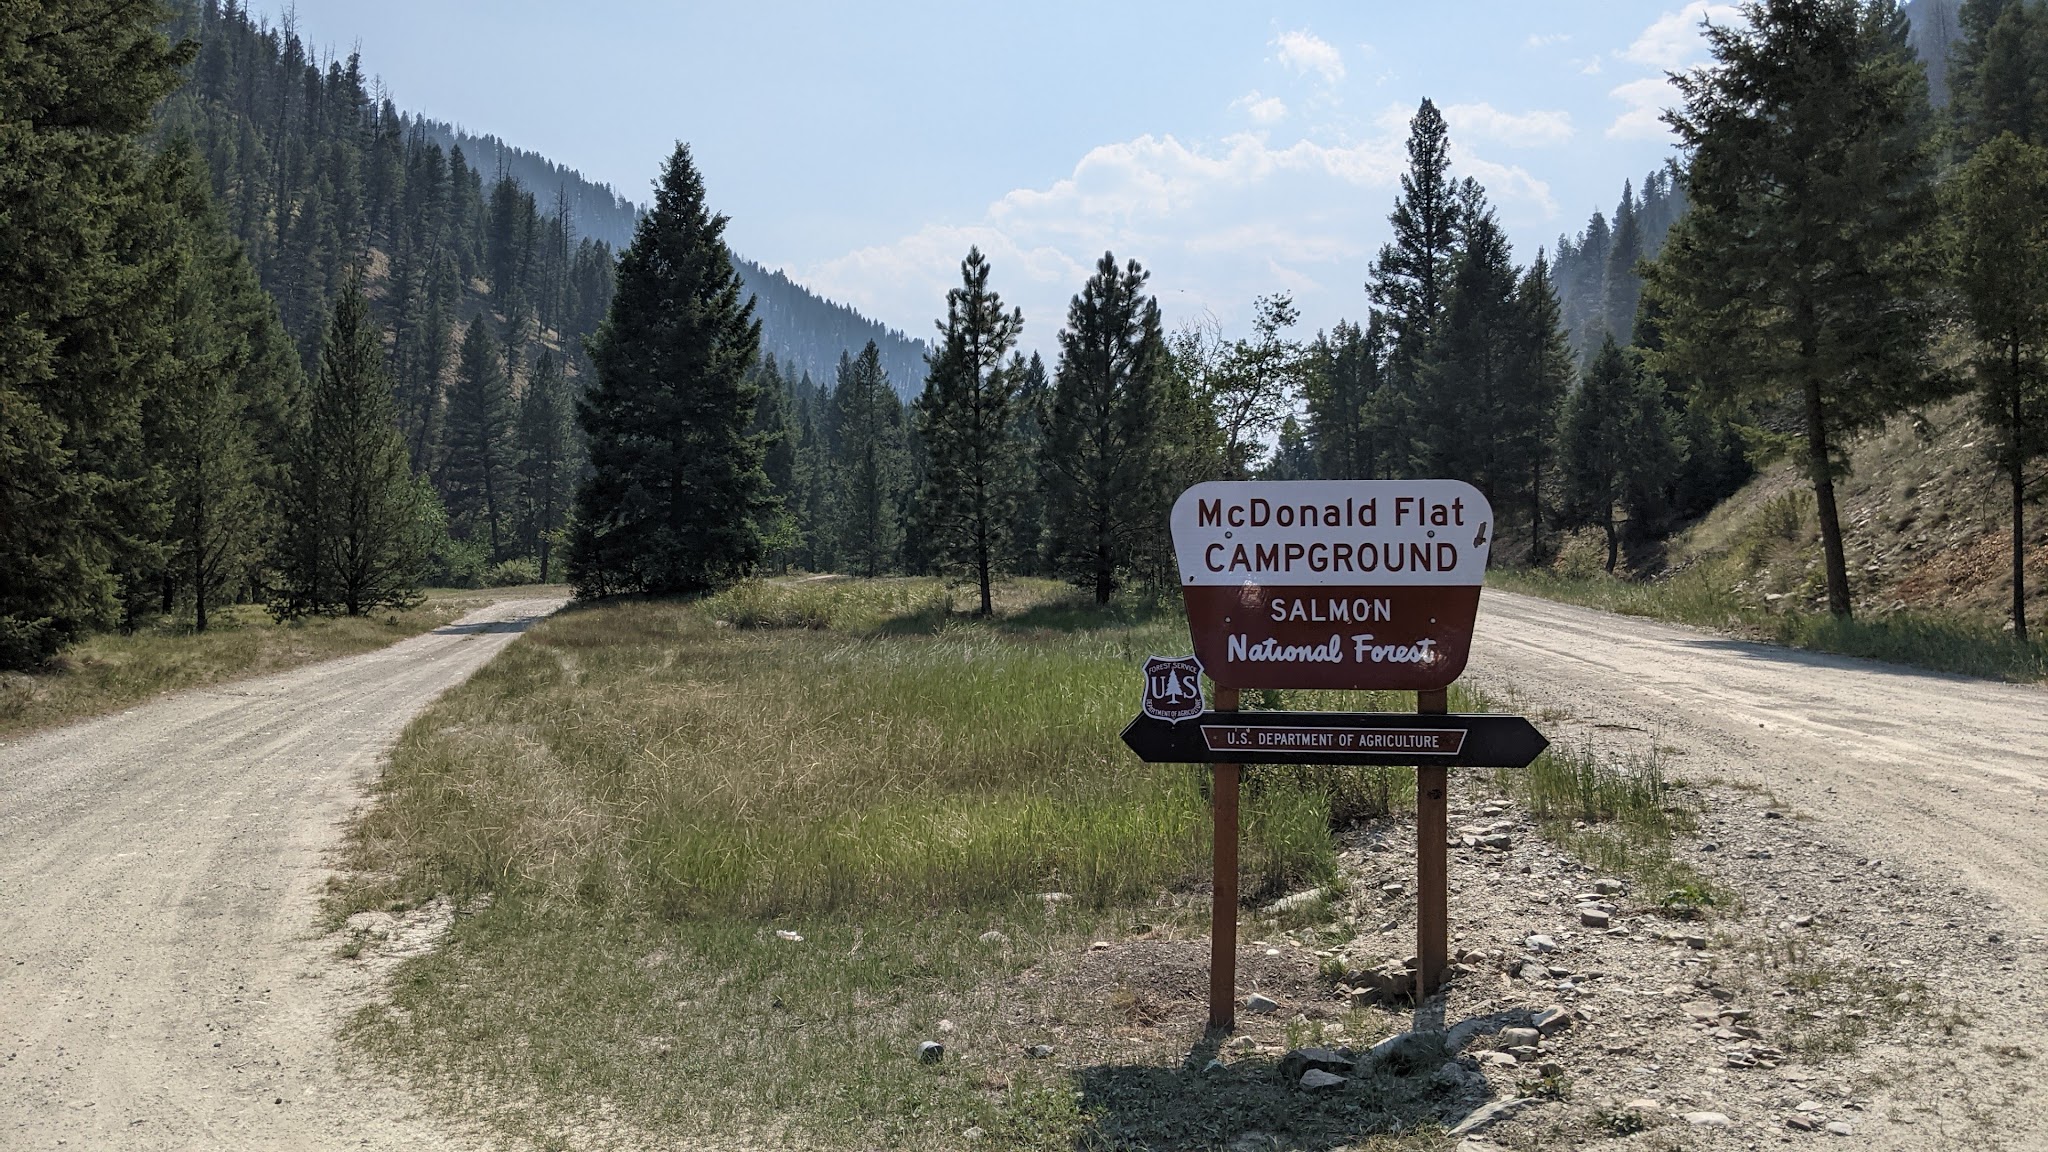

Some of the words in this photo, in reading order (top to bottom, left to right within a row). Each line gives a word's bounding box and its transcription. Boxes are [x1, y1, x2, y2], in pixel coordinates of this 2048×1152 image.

[1198, 497, 1377, 527] McDonald
[1395, 496, 1464, 526] Flat
[1205, 542, 1458, 572] CAMPGROUND
[1270, 598, 1391, 622] SALMON
[1227, 633, 1343, 663] National
[1351, 634, 1437, 663] Forest
[1148, 662, 1171, 675] FOREST
[1172, 662, 1198, 674] SERVICE
[1227, 732, 1252, 745] U.S.
[1258, 732, 1333, 747] DEPARTMENT
[1338, 733, 1354, 747] OF
[1358, 734, 1439, 748] AGRICULTURE
